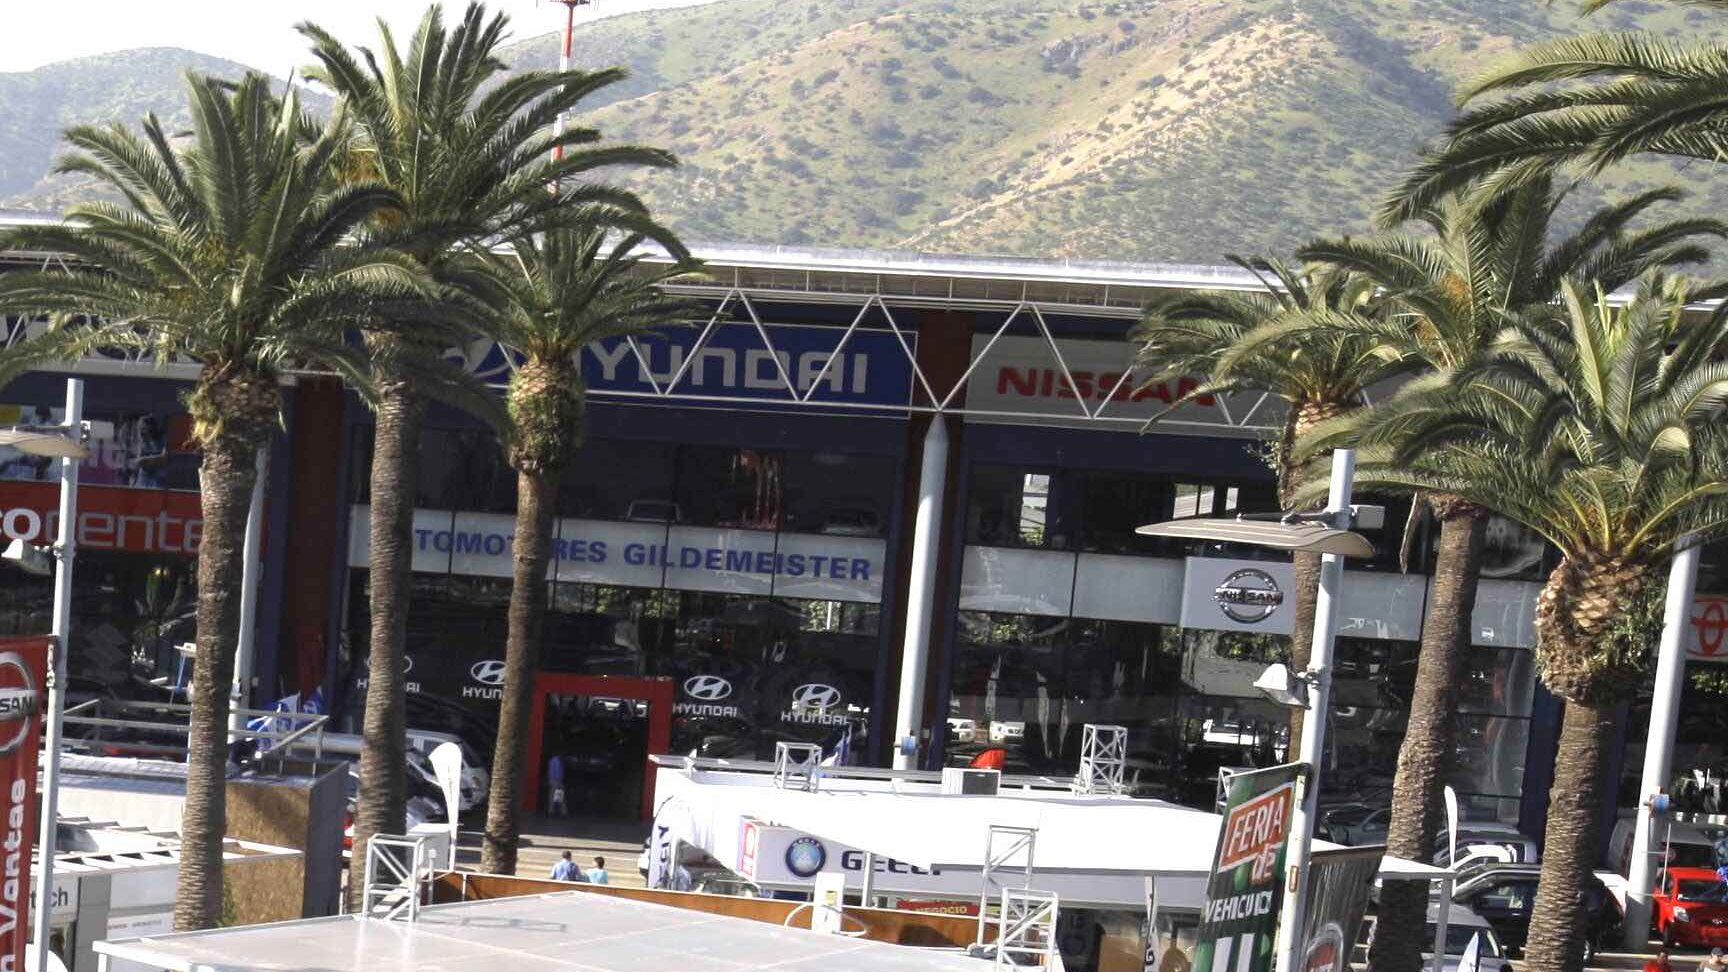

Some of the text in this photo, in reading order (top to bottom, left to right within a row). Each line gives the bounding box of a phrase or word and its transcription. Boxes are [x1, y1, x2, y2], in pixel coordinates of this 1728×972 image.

[572, 338, 868, 393] YUNDAI
[414, 526, 872, 582] TOMORES GILDEMEISTER
[462, 685, 504, 701] HYUN
[673, 703, 738, 719] HYUNDAI
[1227, 795, 1285, 857] FERIA
